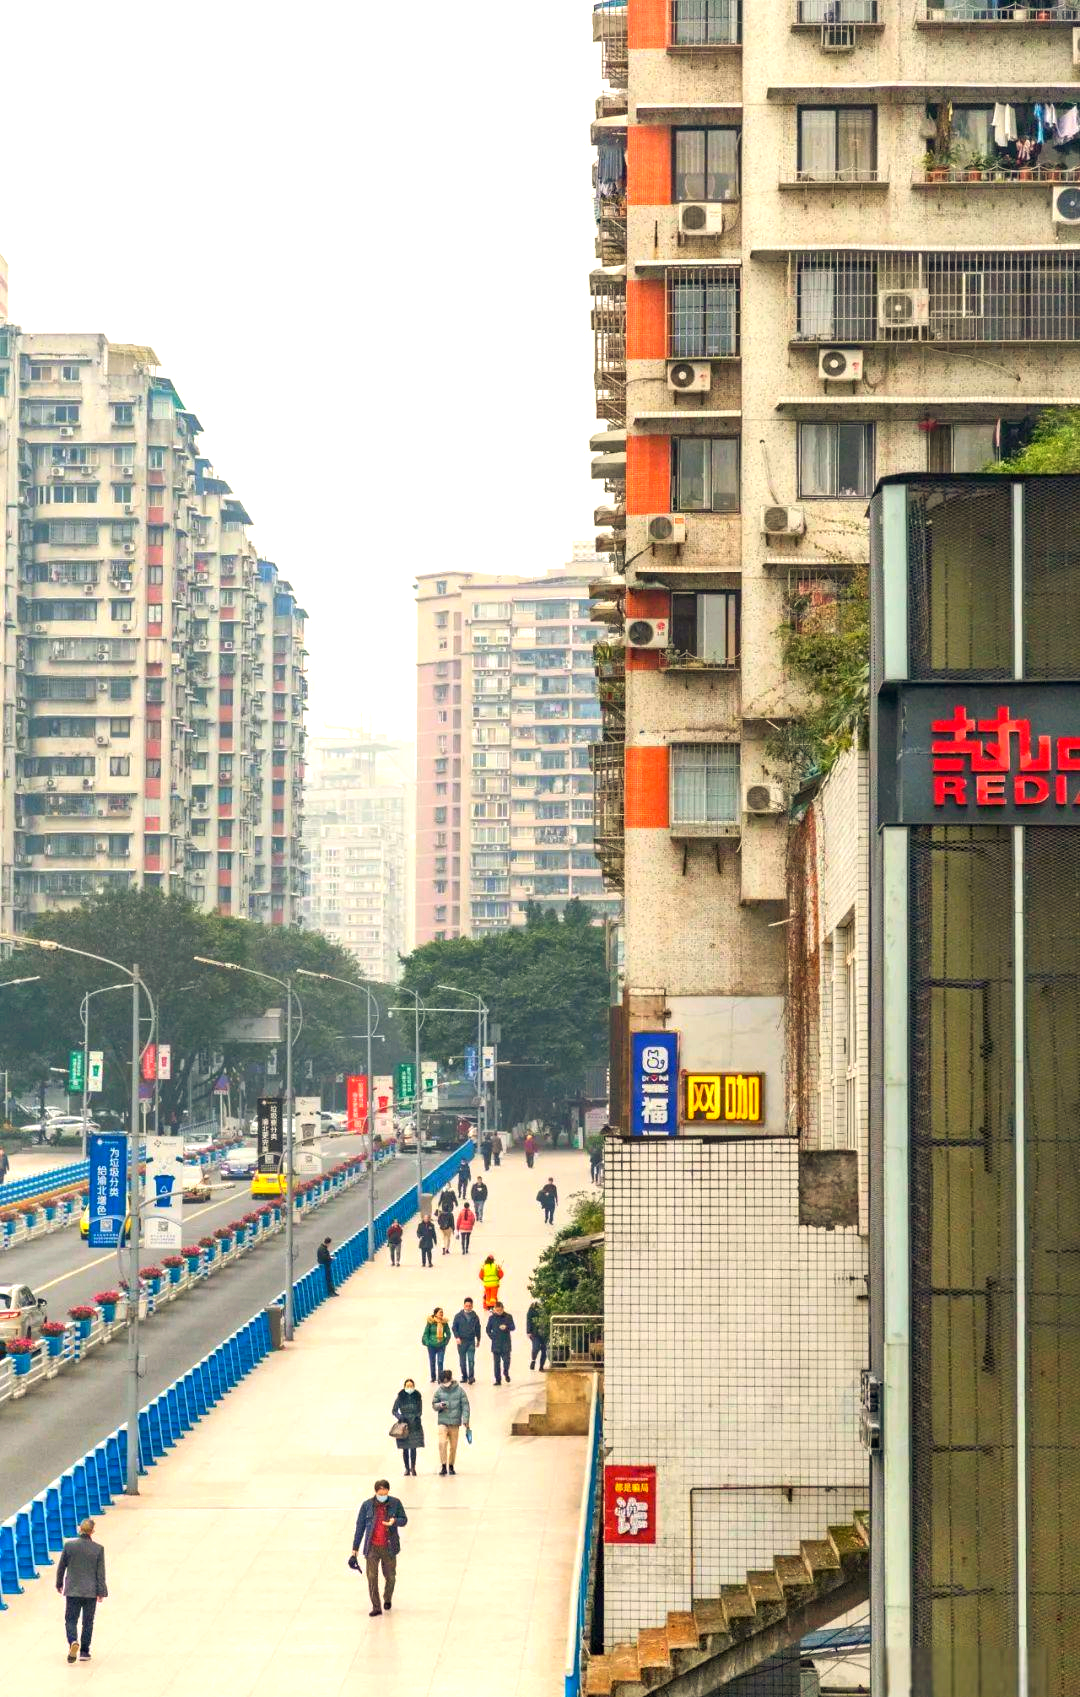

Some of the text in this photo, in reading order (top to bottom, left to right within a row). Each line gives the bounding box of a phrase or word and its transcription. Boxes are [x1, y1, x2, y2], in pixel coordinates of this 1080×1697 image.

[933, 775, 1080, 806] REDI
[687, 1074, 760, 1121] 网咖
[97, 1165, 107, 1216] 给渝北增色
[109, 1147, 120, 1197] 为垃圾分类
